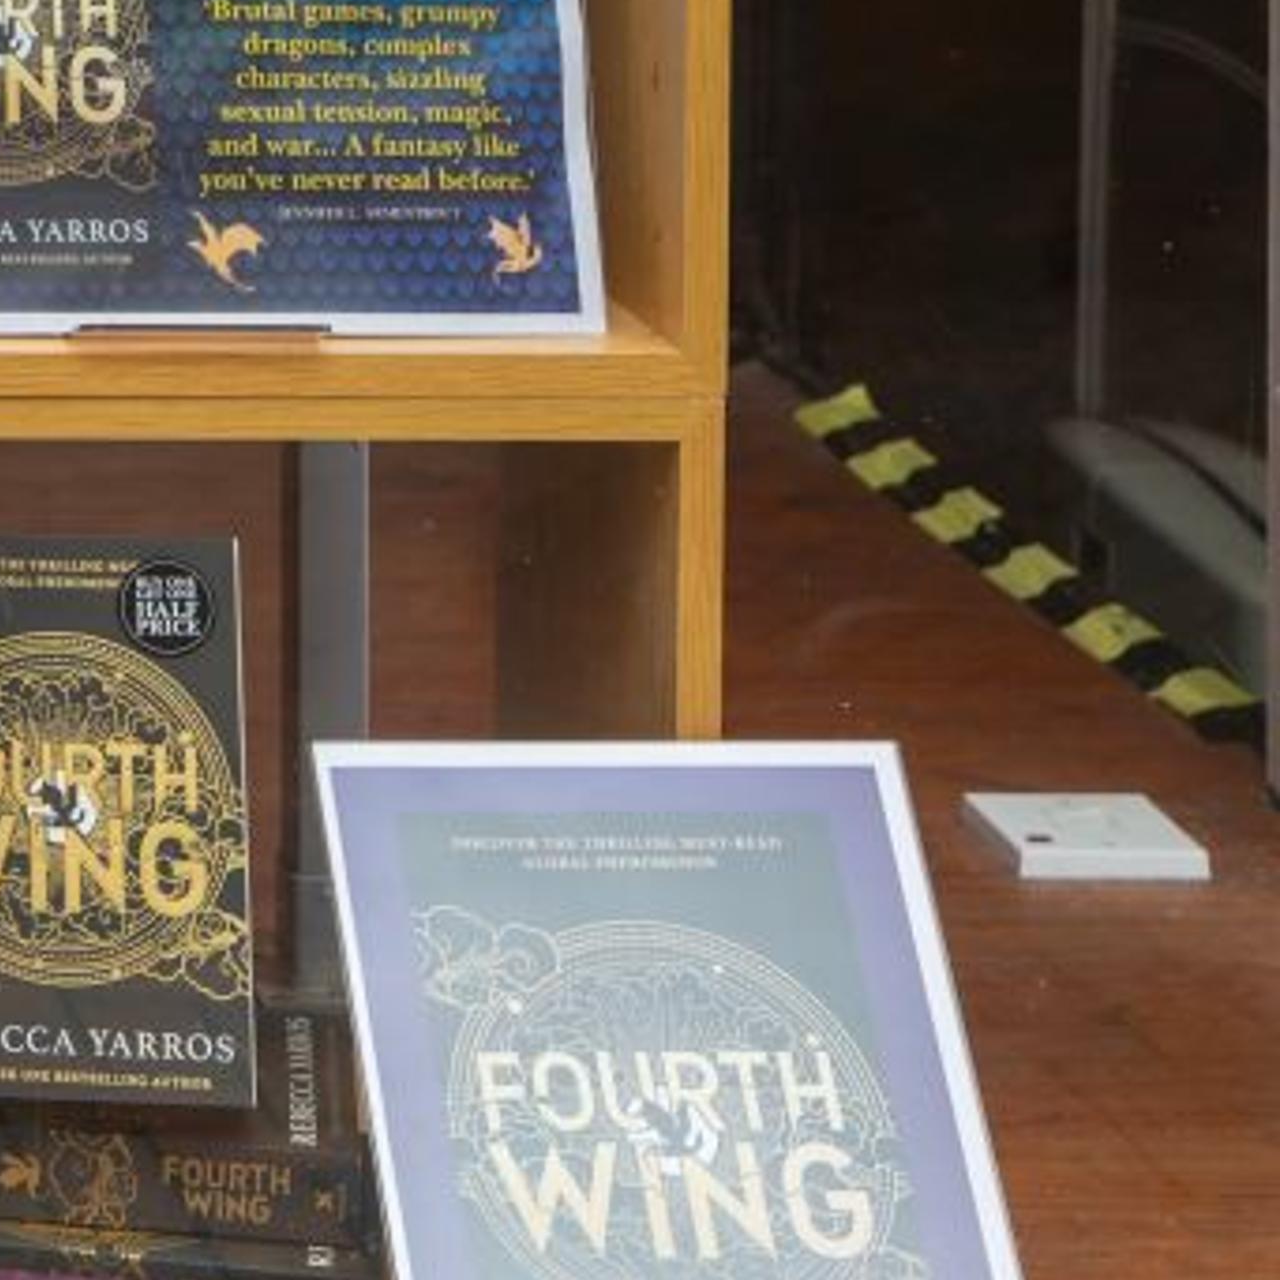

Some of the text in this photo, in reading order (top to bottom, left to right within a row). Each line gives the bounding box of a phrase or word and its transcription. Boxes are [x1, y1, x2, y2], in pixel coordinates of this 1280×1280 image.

[302, 3, 394, 28] games,
[399, 2, 501, 29] grumpy
[242, 31, 473, 64] dragons, complex
[235, 66, 488, 96] characters, sizzling
[218, 99, 514, 131] sexual tension, magic,
[205, 132, 259, 158] and
[343, 133, 366, 158] A
[371, 132, 467, 164] fantasy
[472, 133, 521, 159] like
[291, 172, 373, 192] never
[372, 166, 430, 192] read
[26, 219, 151, 245] YARROS
[135, 600, 202, 618] HALF
[135, 618, 202, 637] PRICE
[89, 1028, 237, 1064] YARROS
[473, 1050, 843, 1134] FOURTH
[162, 1154, 292, 1196] FOURTH
[183, 1187, 272, 1226] WING
[486, 1140, 877, 1263] WING
